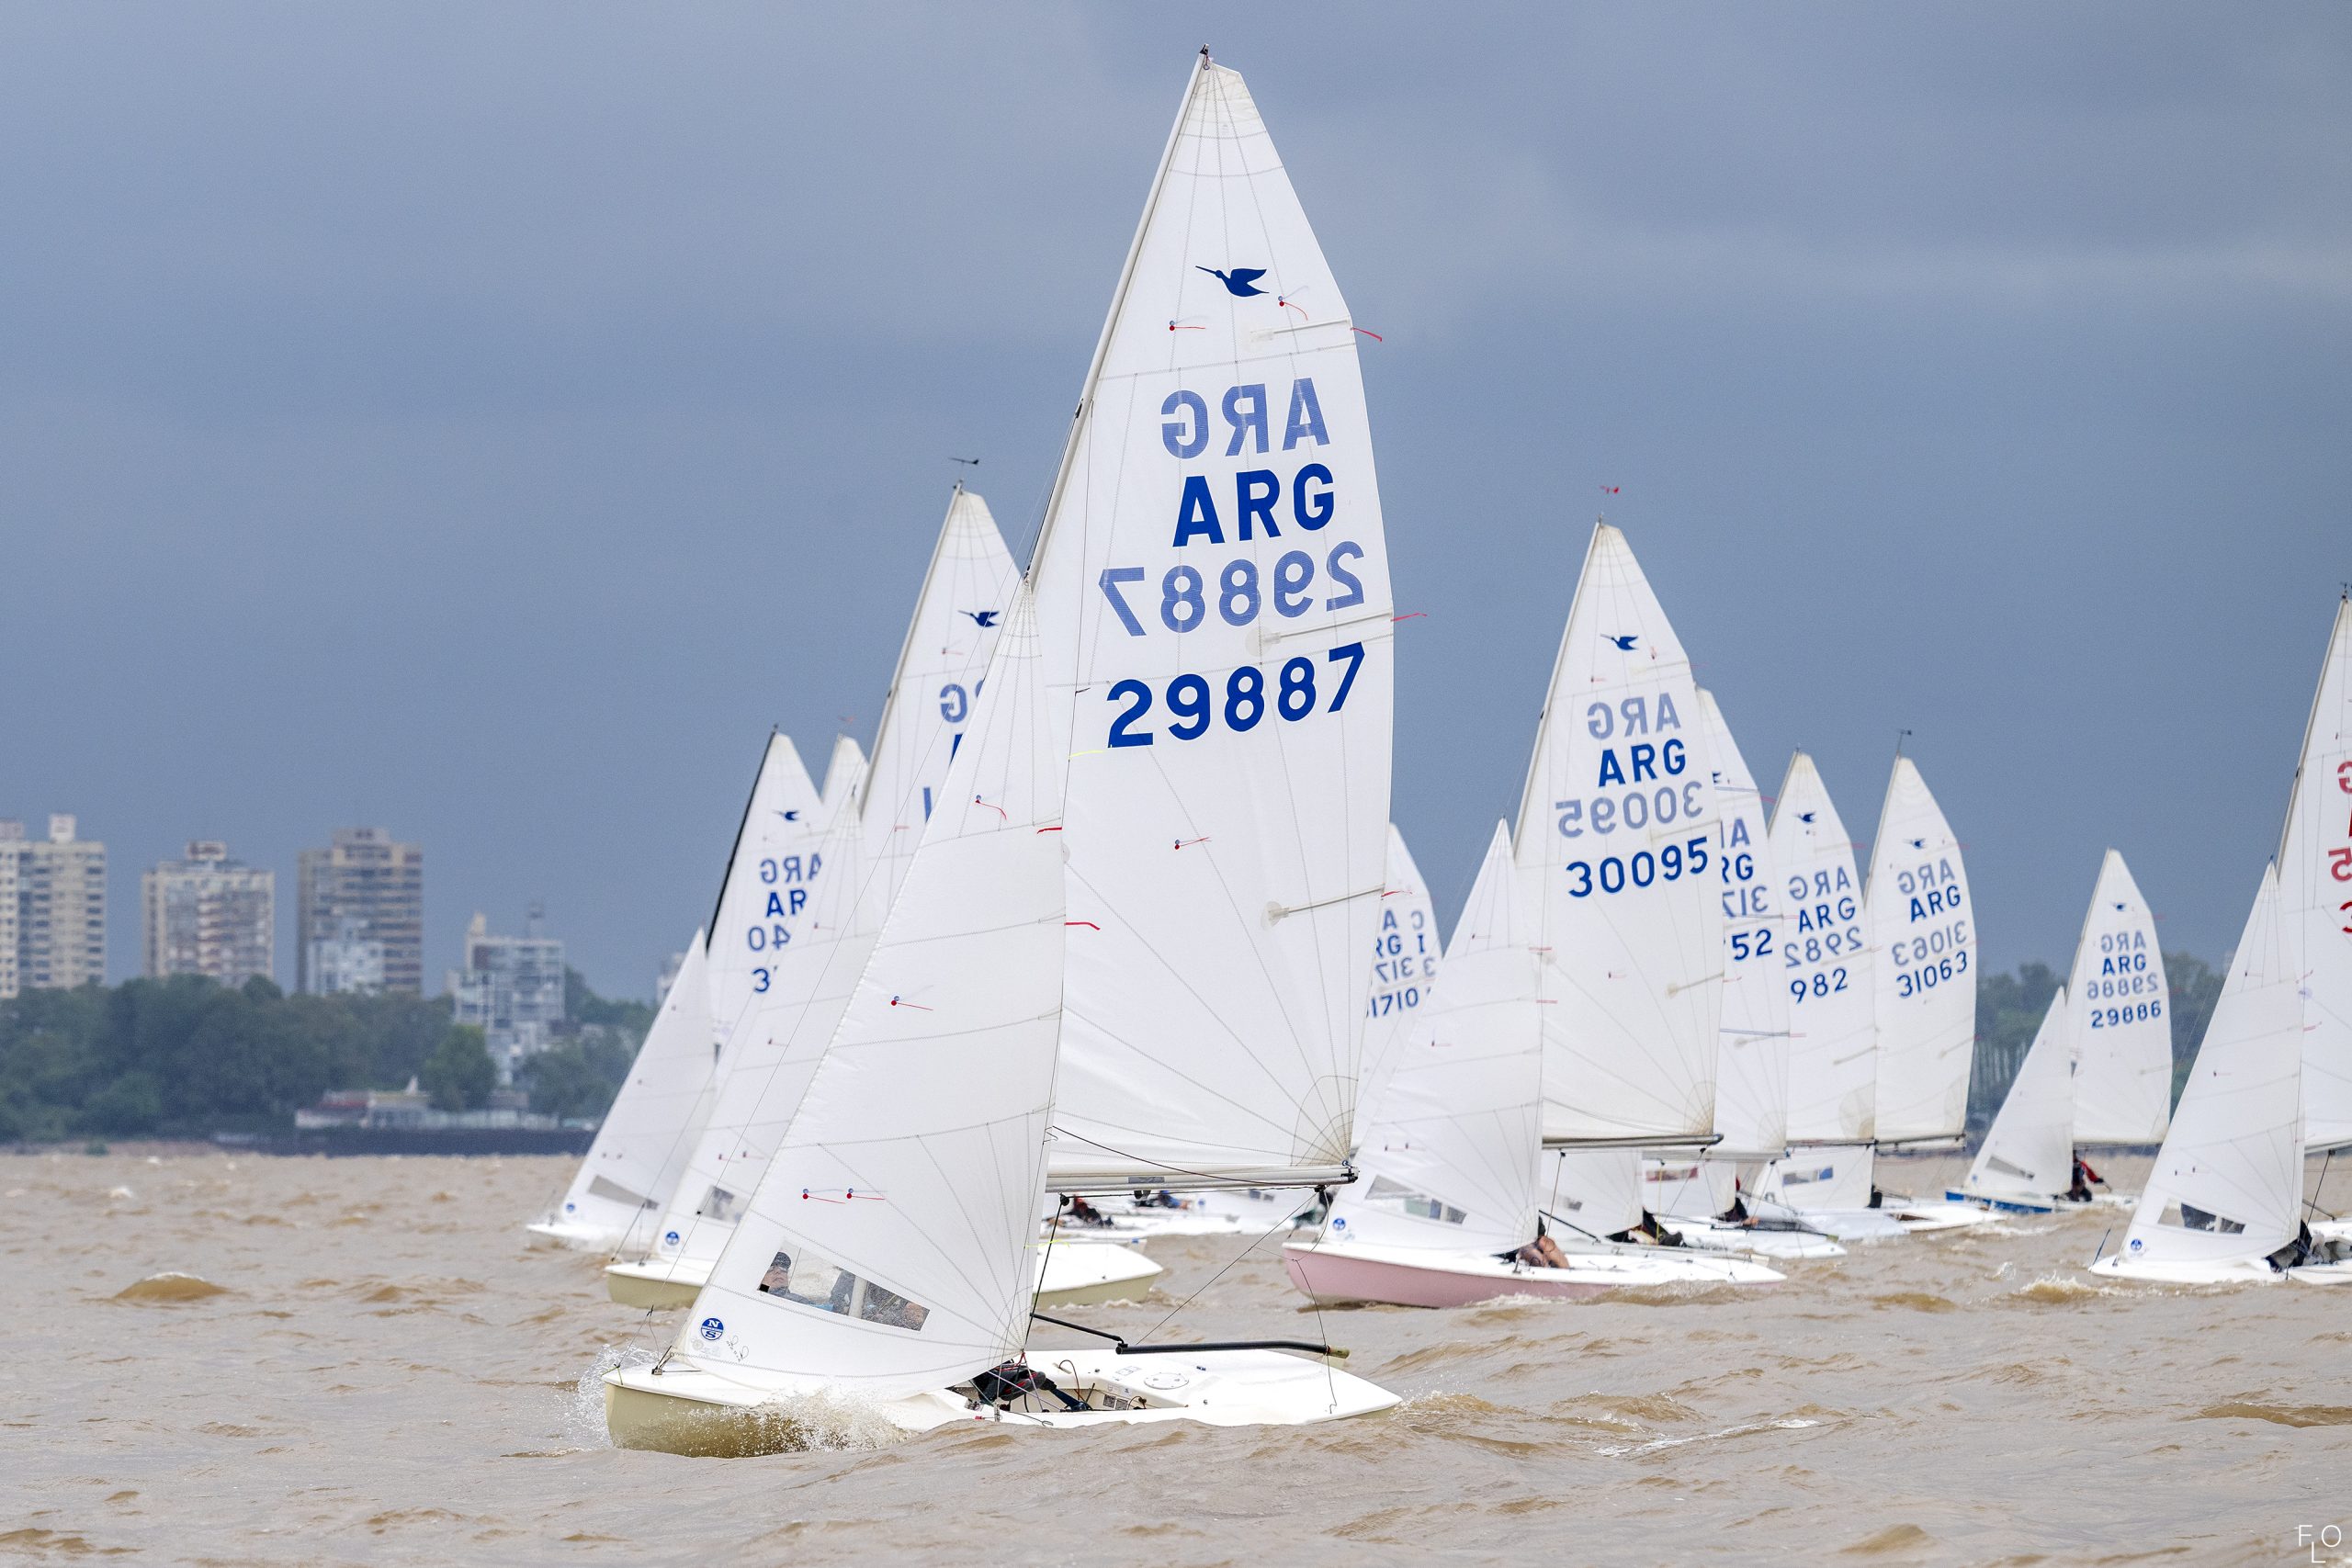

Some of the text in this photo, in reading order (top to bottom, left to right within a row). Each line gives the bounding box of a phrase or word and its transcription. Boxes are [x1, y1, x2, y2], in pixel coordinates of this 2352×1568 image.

[1172, 463, 1335, 547] ARG
[1107, 641, 1365, 748] 29887
[1599, 739, 1687, 788] ARG
[1566, 834, 1708, 897] 30095
[1798, 897, 1856, 933] ARG
[1910, 884, 1960, 922] ARG
[1895, 950, 1967, 997] 31063
[2102, 954, 2145, 976] ARG
[1366, 987, 1419, 1017] 1710
[2092, 1000, 2161, 1028] 29886
